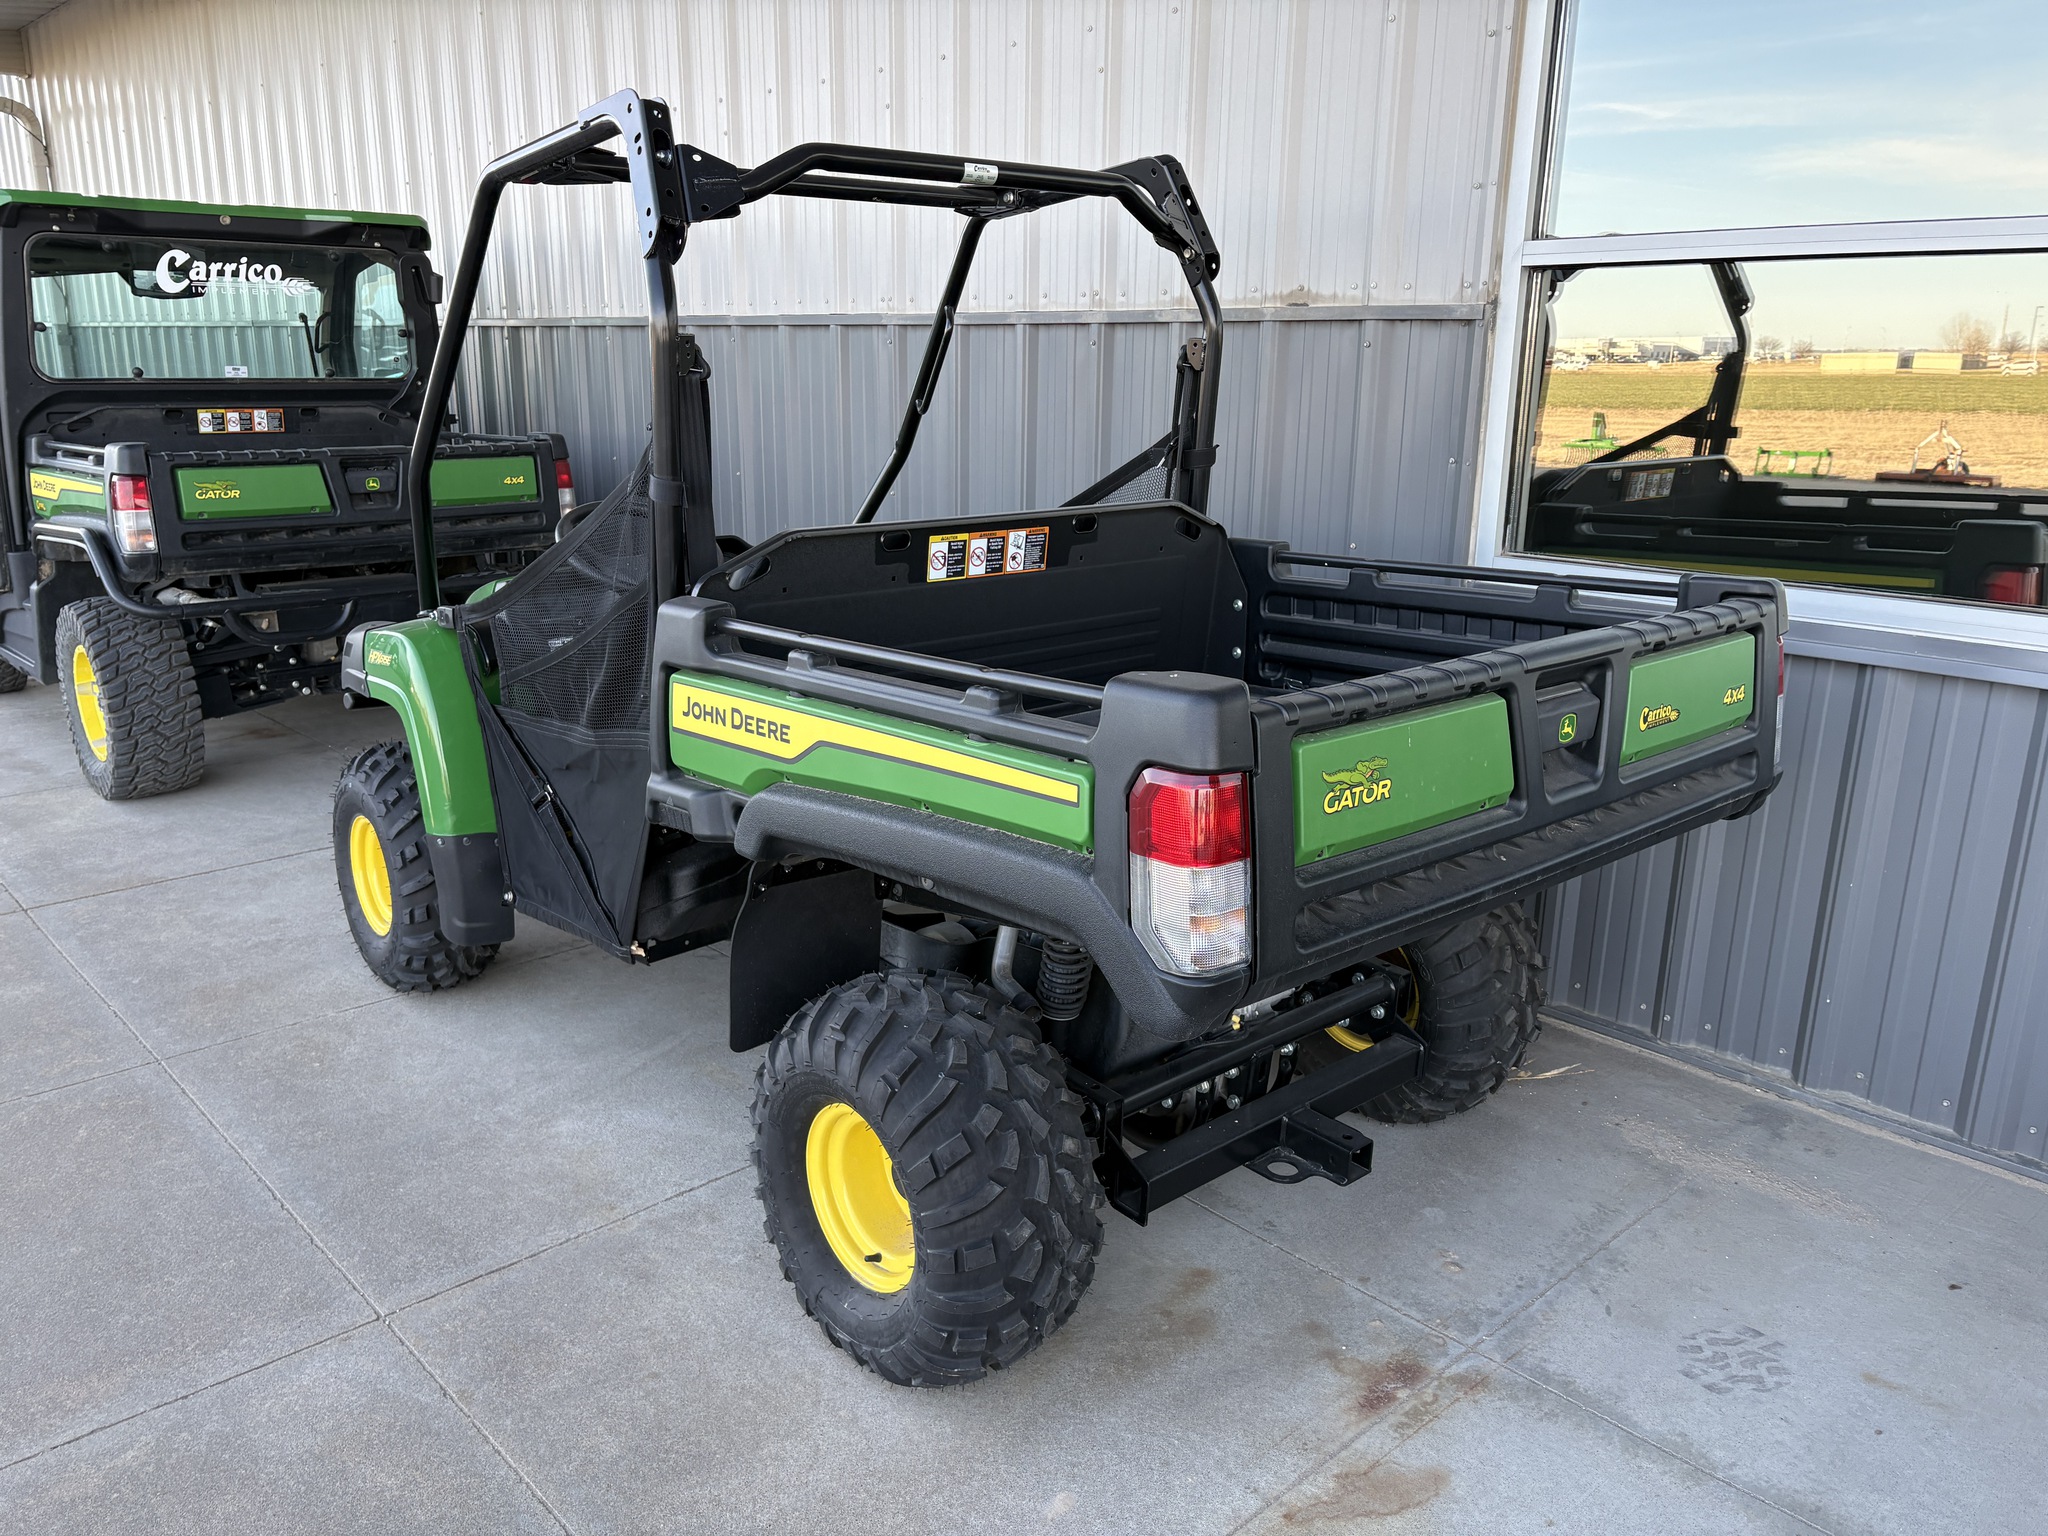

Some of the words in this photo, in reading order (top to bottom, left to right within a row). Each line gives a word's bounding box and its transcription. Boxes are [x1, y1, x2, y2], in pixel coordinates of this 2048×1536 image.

[156, 249, 282, 294] Carrico
[191, 286, 278, 295] IMPLEMENT
[195, 489, 241, 500] GATOR
[682, 696, 727, 727] JOHN
[731, 707, 791, 744] DEERE
[1639, 704, 1672, 732] Carrico
[1323, 779, 1392, 814] GATOR
